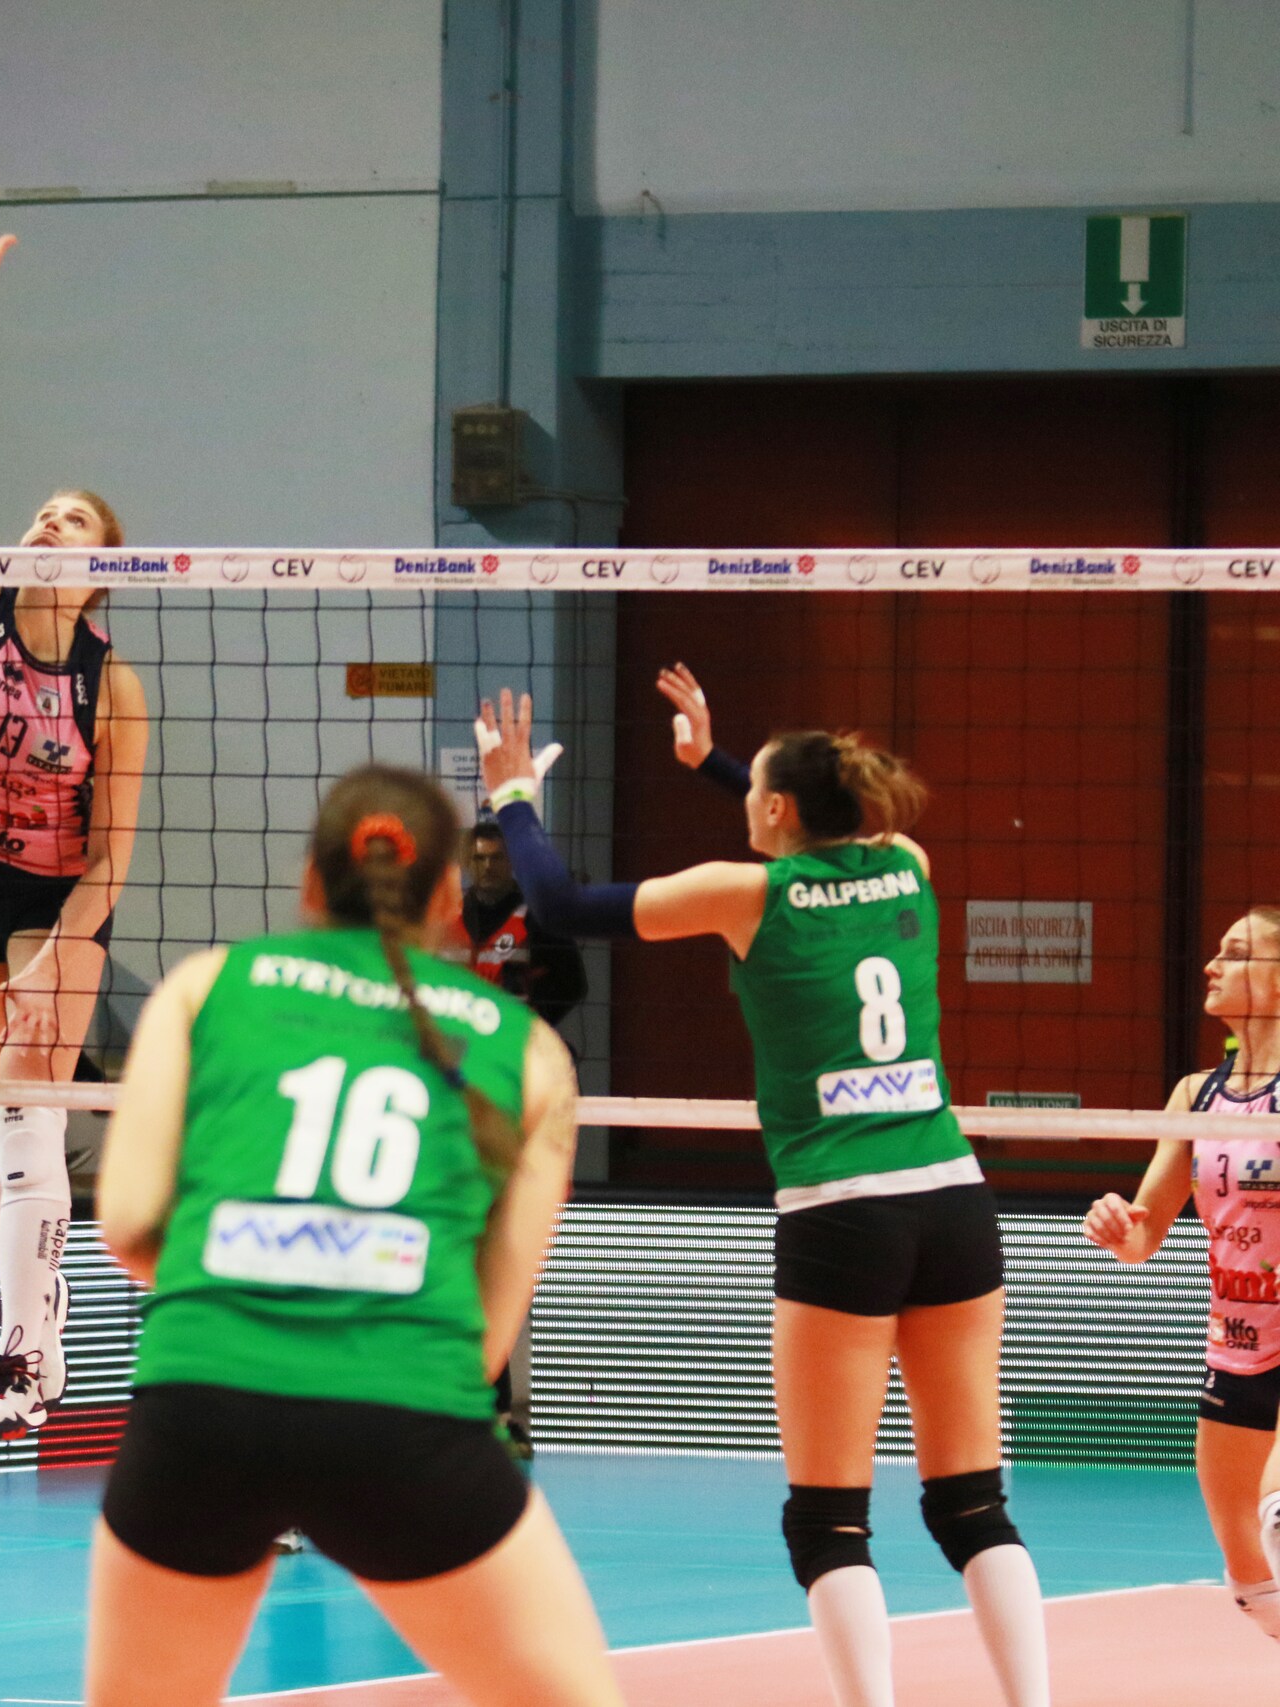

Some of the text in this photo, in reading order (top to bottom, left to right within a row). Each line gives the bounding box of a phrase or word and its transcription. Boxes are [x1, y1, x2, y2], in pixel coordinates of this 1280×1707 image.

[1099, 319, 1167, 333] USCITA DI
[1093, 335, 1172, 347] SICUREZZA
[90, 556, 168, 572] DenizBank
[272, 559, 314, 577] CEV
[395, 556, 475, 573] DenizBank
[582, 560, 625, 578] CEV
[708, 557, 791, 574] DenizBank
[900, 560, 945, 579] CEV
[1030, 558, 1116, 575] DenizBank
[1227, 559, 1274, 578] CEV
[379, 668, 431, 678] VIETATO
[971, 917, 1008, 937] USCITA
[1025, 916, 1087, 938] SICUREZZA
[974, 947, 1030, 968] APERTURA
[855, 956, 906, 1062] 8
[274, 1055, 430, 1209] 16
[1215, 1153, 1228, 1197] 3
[48, 1217, 70, 1272] Capelli
